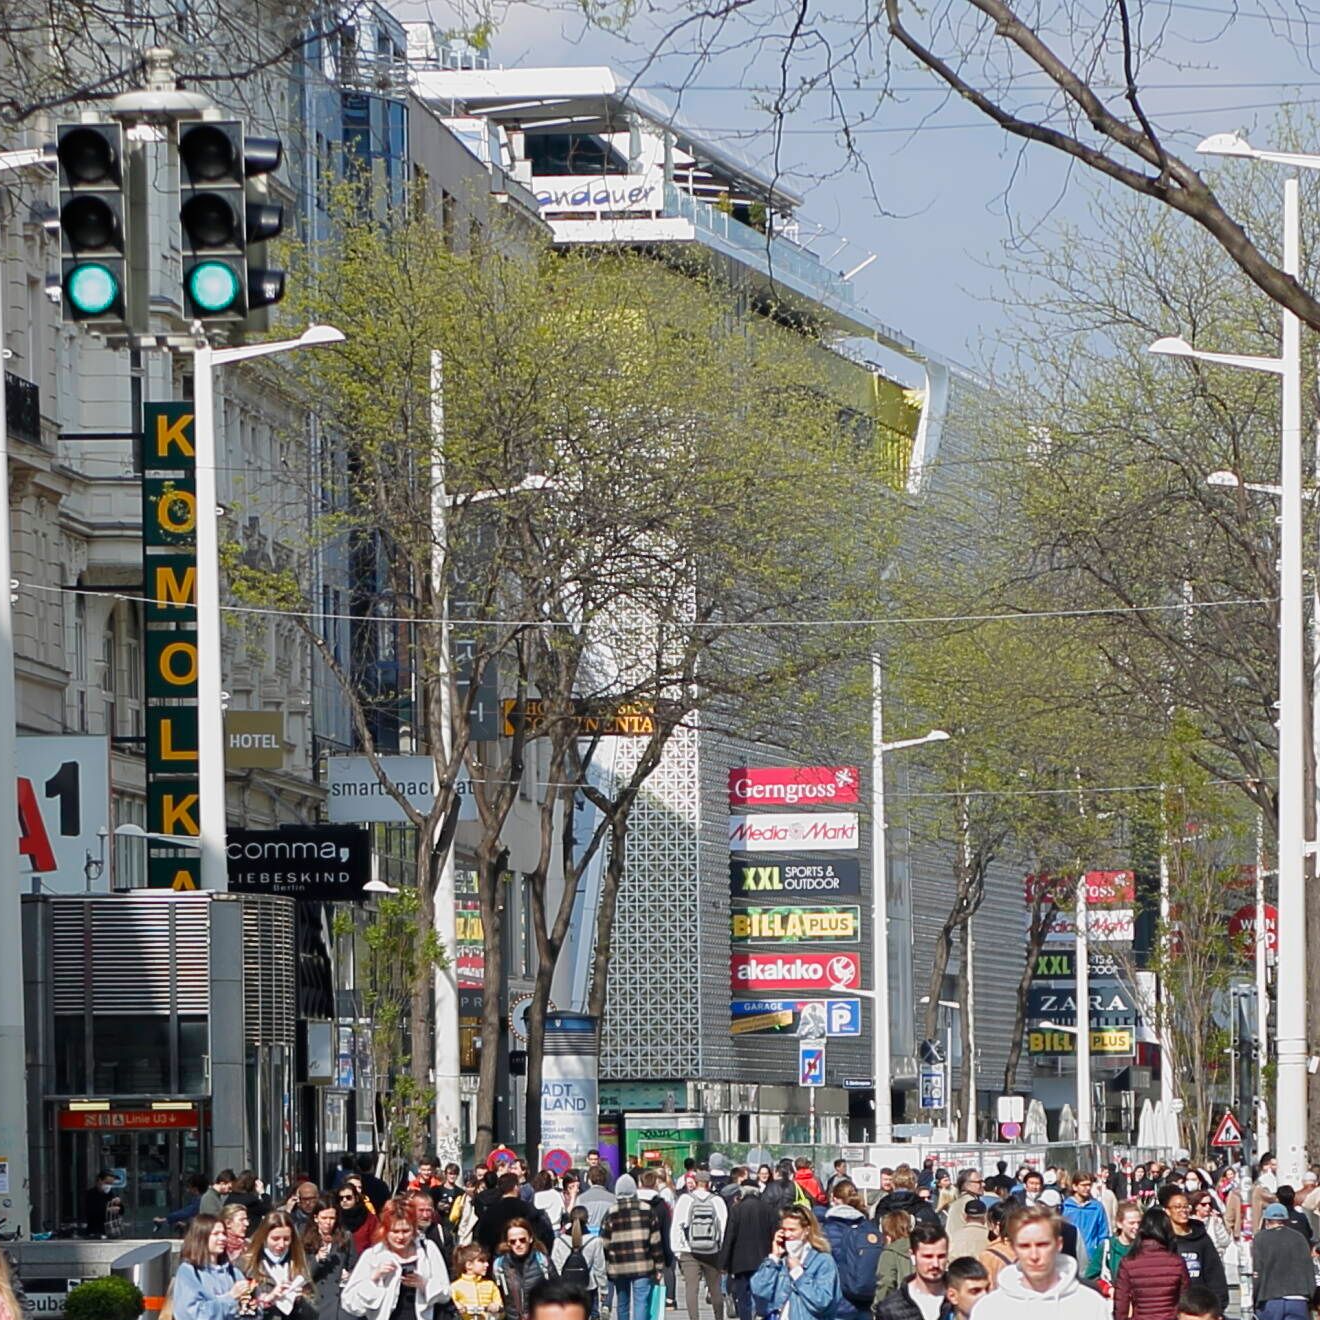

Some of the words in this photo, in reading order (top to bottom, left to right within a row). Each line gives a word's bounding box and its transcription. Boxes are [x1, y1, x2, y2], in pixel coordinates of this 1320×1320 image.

[535, 182, 656, 207] andauer
[229, 734, 280, 749] HOTEL
[332, 780, 475, 798] smartpacat
[735, 778, 836, 804] Gerngross
[730, 823, 789, 841] Media
[802, 822, 857, 841] Markt
[226, 839, 350, 864] comma,
[226, 872, 350, 884] LIEBESKIND
[742, 866, 784, 891] XXL
[785, 866, 825, 878] SPORTS
[825, 866, 835, 877] &
[784, 877, 840, 890] OUTDOOR
[273, 884, 306, 892] Berlin
[733, 913, 804, 938] BILLA
[809, 917, 850, 932] PLUS
[737, 959, 824, 981] akakiko
[1036, 956, 1071, 975] XXL
[743, 1002, 784, 1011] GARAGE
[1040, 996, 1129, 1011] ZARA
[1031, 1034, 1076, 1051] BILL
[1093, 1036, 1126, 1048] PLUS
[541, 1083, 573, 1097] ADT
[544, 1097, 587, 1111] LAND
[125, 1114, 151, 1124] Linie
[153, 1114, 167, 1124] U3
